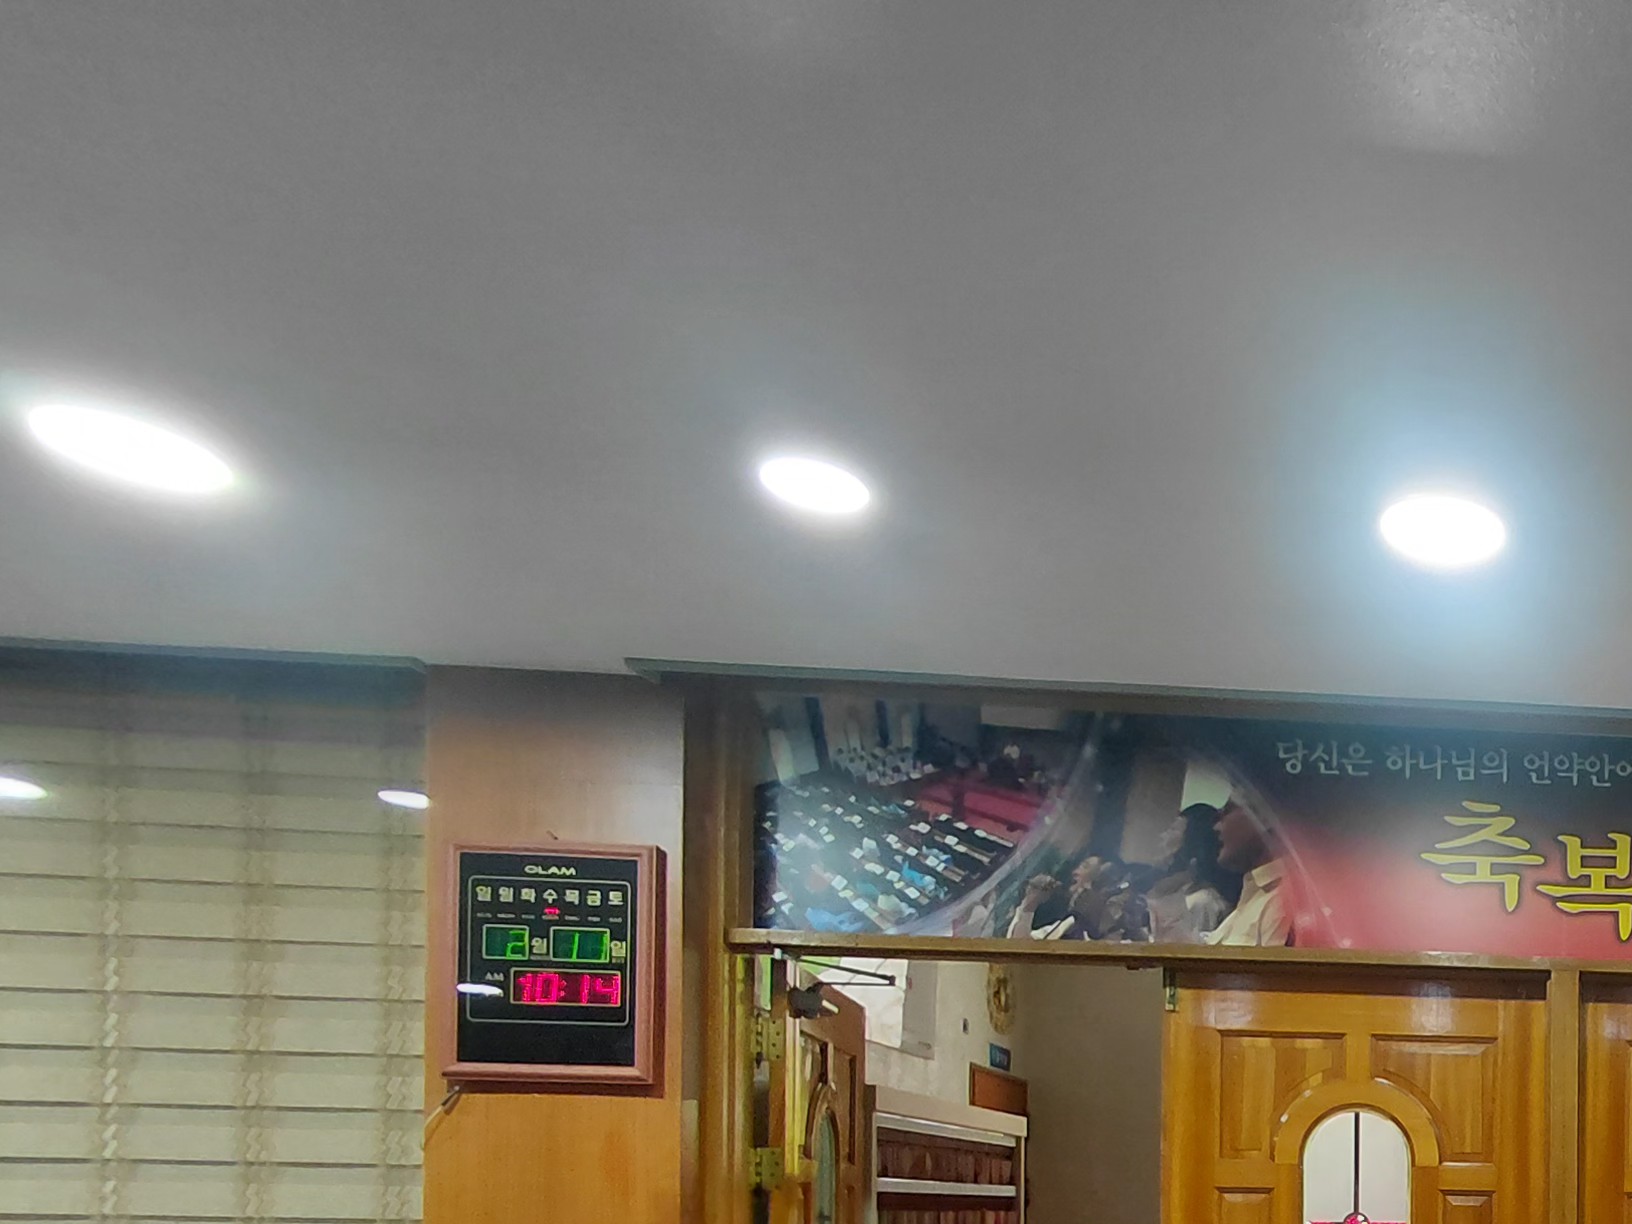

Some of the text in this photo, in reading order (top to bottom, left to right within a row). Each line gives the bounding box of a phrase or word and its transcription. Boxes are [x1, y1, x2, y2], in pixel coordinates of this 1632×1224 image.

[1275, 739, 1373, 776] 당신은
[1385, 744, 1508, 784] 하나님의
[542, 888, 558, 904] 수
[505, 930, 528, 959] 2
[517, 972, 621, 1005] 10:14
